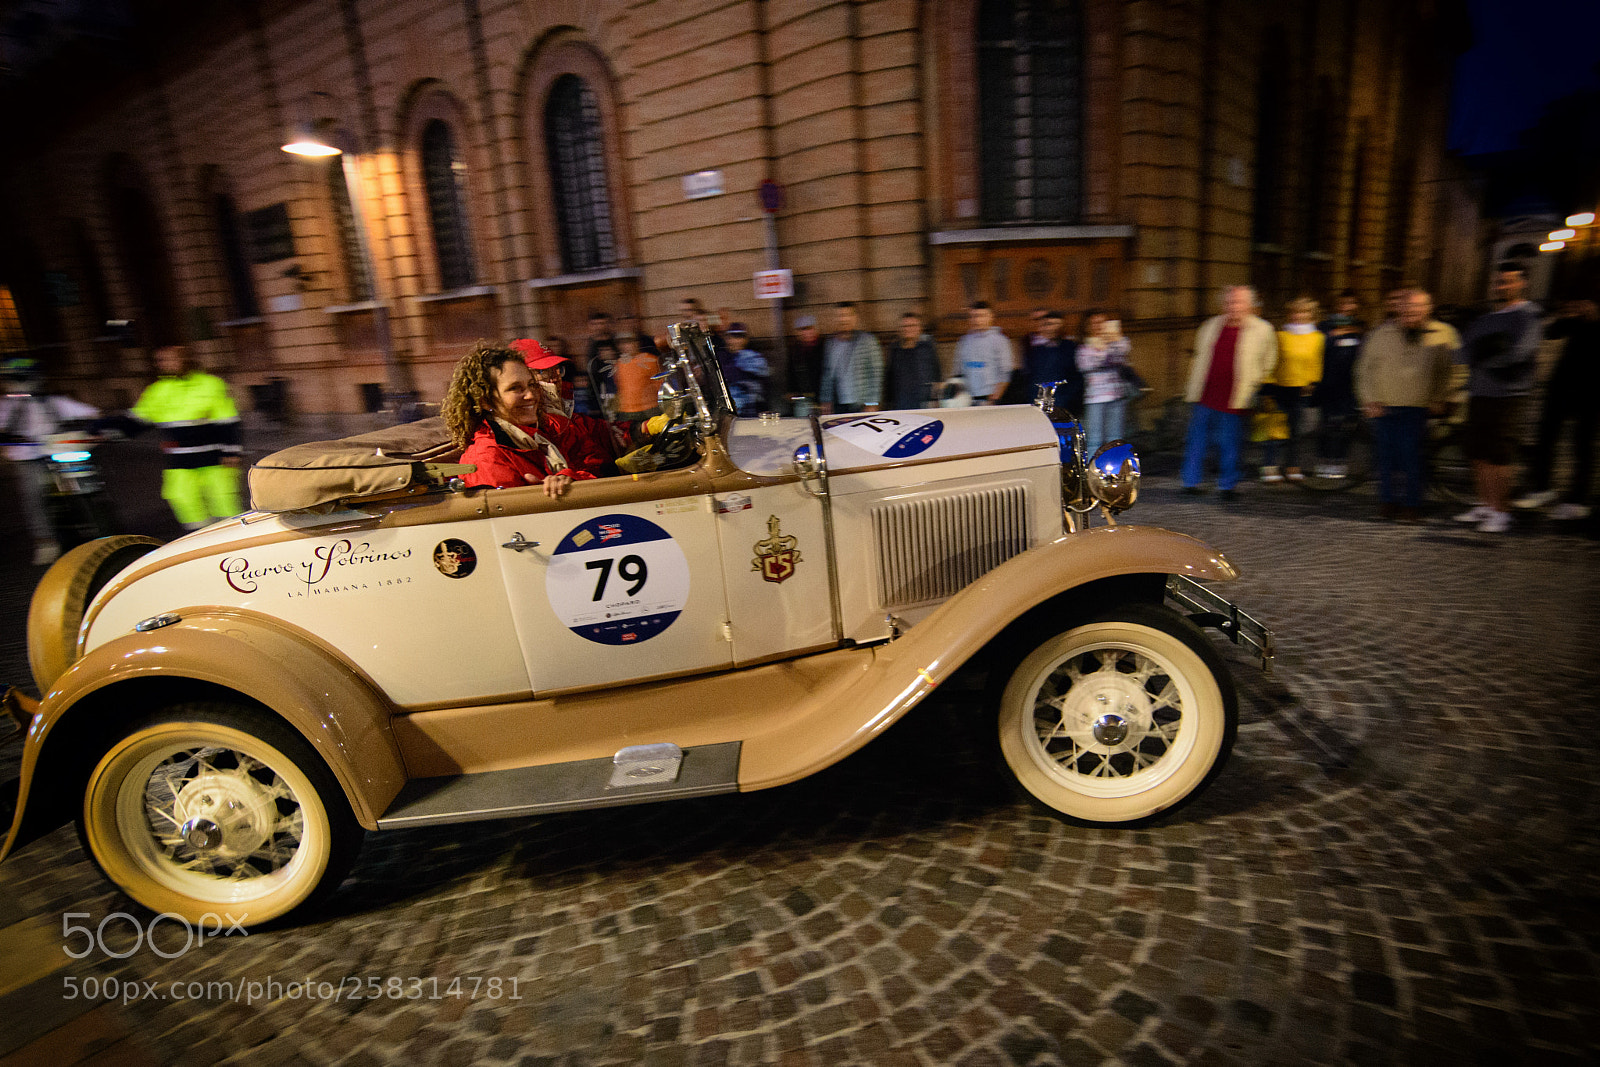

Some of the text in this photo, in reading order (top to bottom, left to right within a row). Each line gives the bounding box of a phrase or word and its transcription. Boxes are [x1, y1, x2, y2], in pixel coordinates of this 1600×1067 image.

[850, 418, 901, 433] 79
[219, 557, 295, 594] Cuervo
[314, 539, 412, 584] Sobrinos
[585, 554, 648, 602] 79
[763, 553, 792, 578] CS
[313, 583, 369, 595] HABANA
[378, 576, 412, 587] 1882
